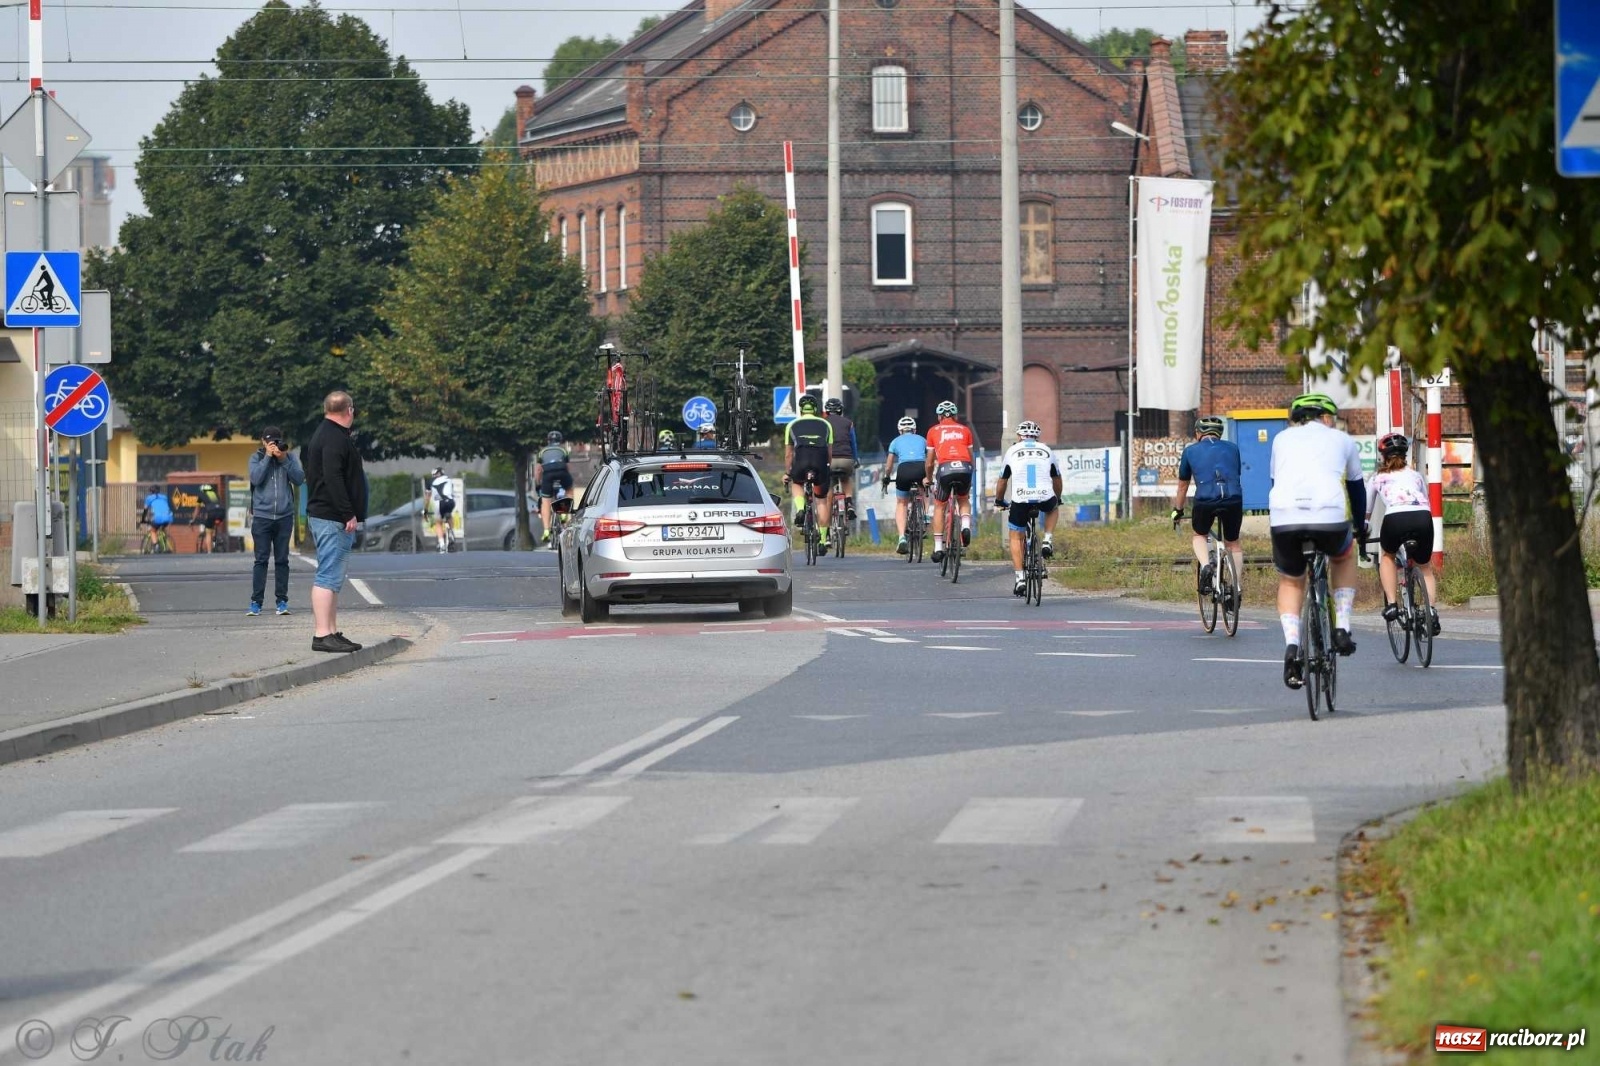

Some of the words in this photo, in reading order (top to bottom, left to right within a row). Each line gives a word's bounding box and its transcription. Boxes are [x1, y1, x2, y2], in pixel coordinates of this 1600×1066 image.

[1170, 197, 1203, 209] FOSFORY
[1017, 450, 1043, 458] BTS
[669, 527, 684, 538] SG
[687, 525, 721, 538] 9347V
[652, 548, 683, 556] GRUPA
[686, 546, 736, 556] KOLARSKA
